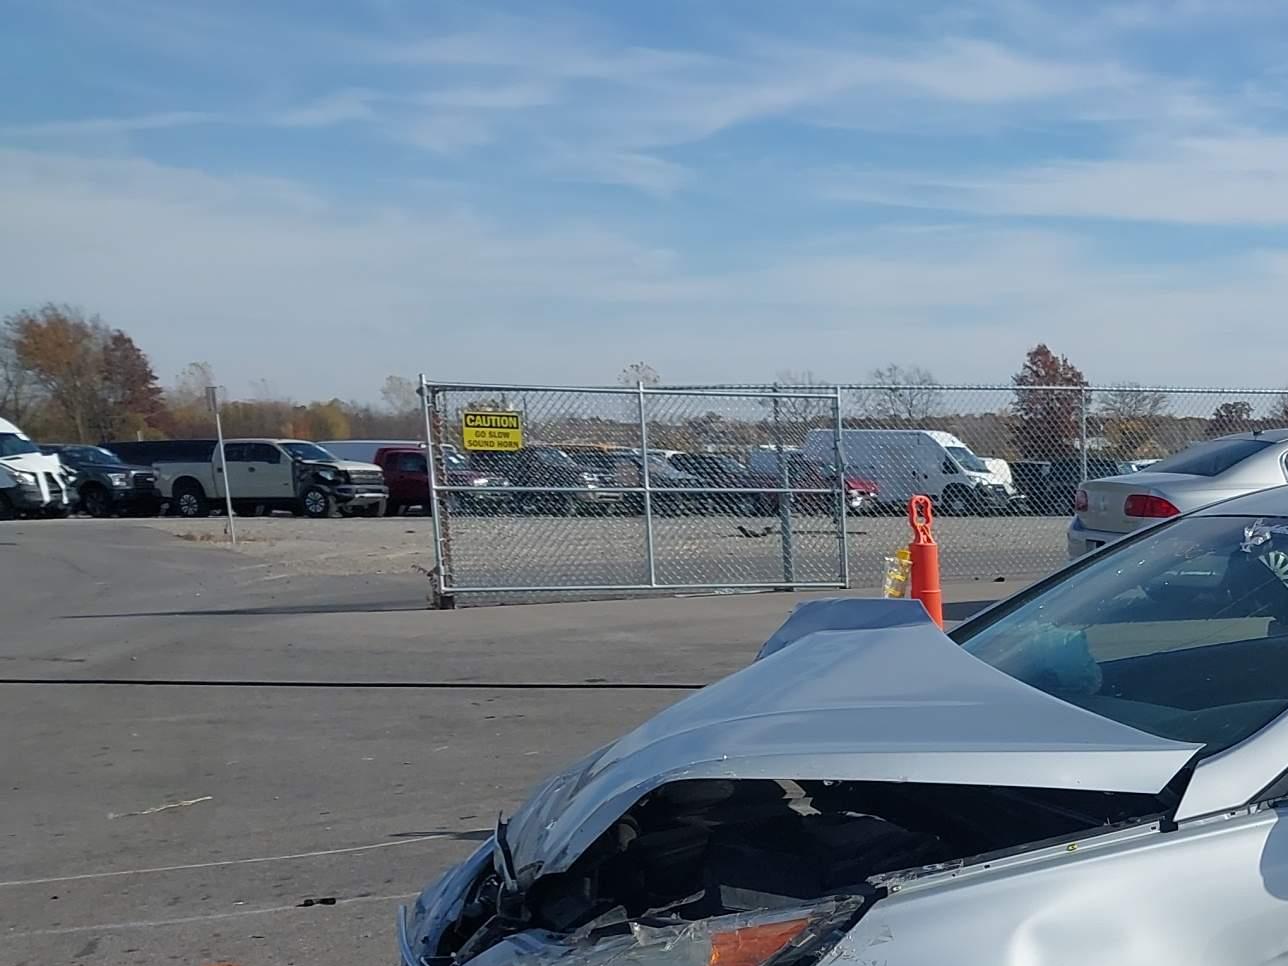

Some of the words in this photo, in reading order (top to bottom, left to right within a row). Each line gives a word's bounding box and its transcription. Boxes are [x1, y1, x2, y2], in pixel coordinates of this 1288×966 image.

[466, 415, 517, 428] CAUTION
[474, 430, 486, 438] GO
[488, 431, 510, 439] SLOW
[467, 440, 495, 448] SOUND
[497, 441, 519, 449] HORN
